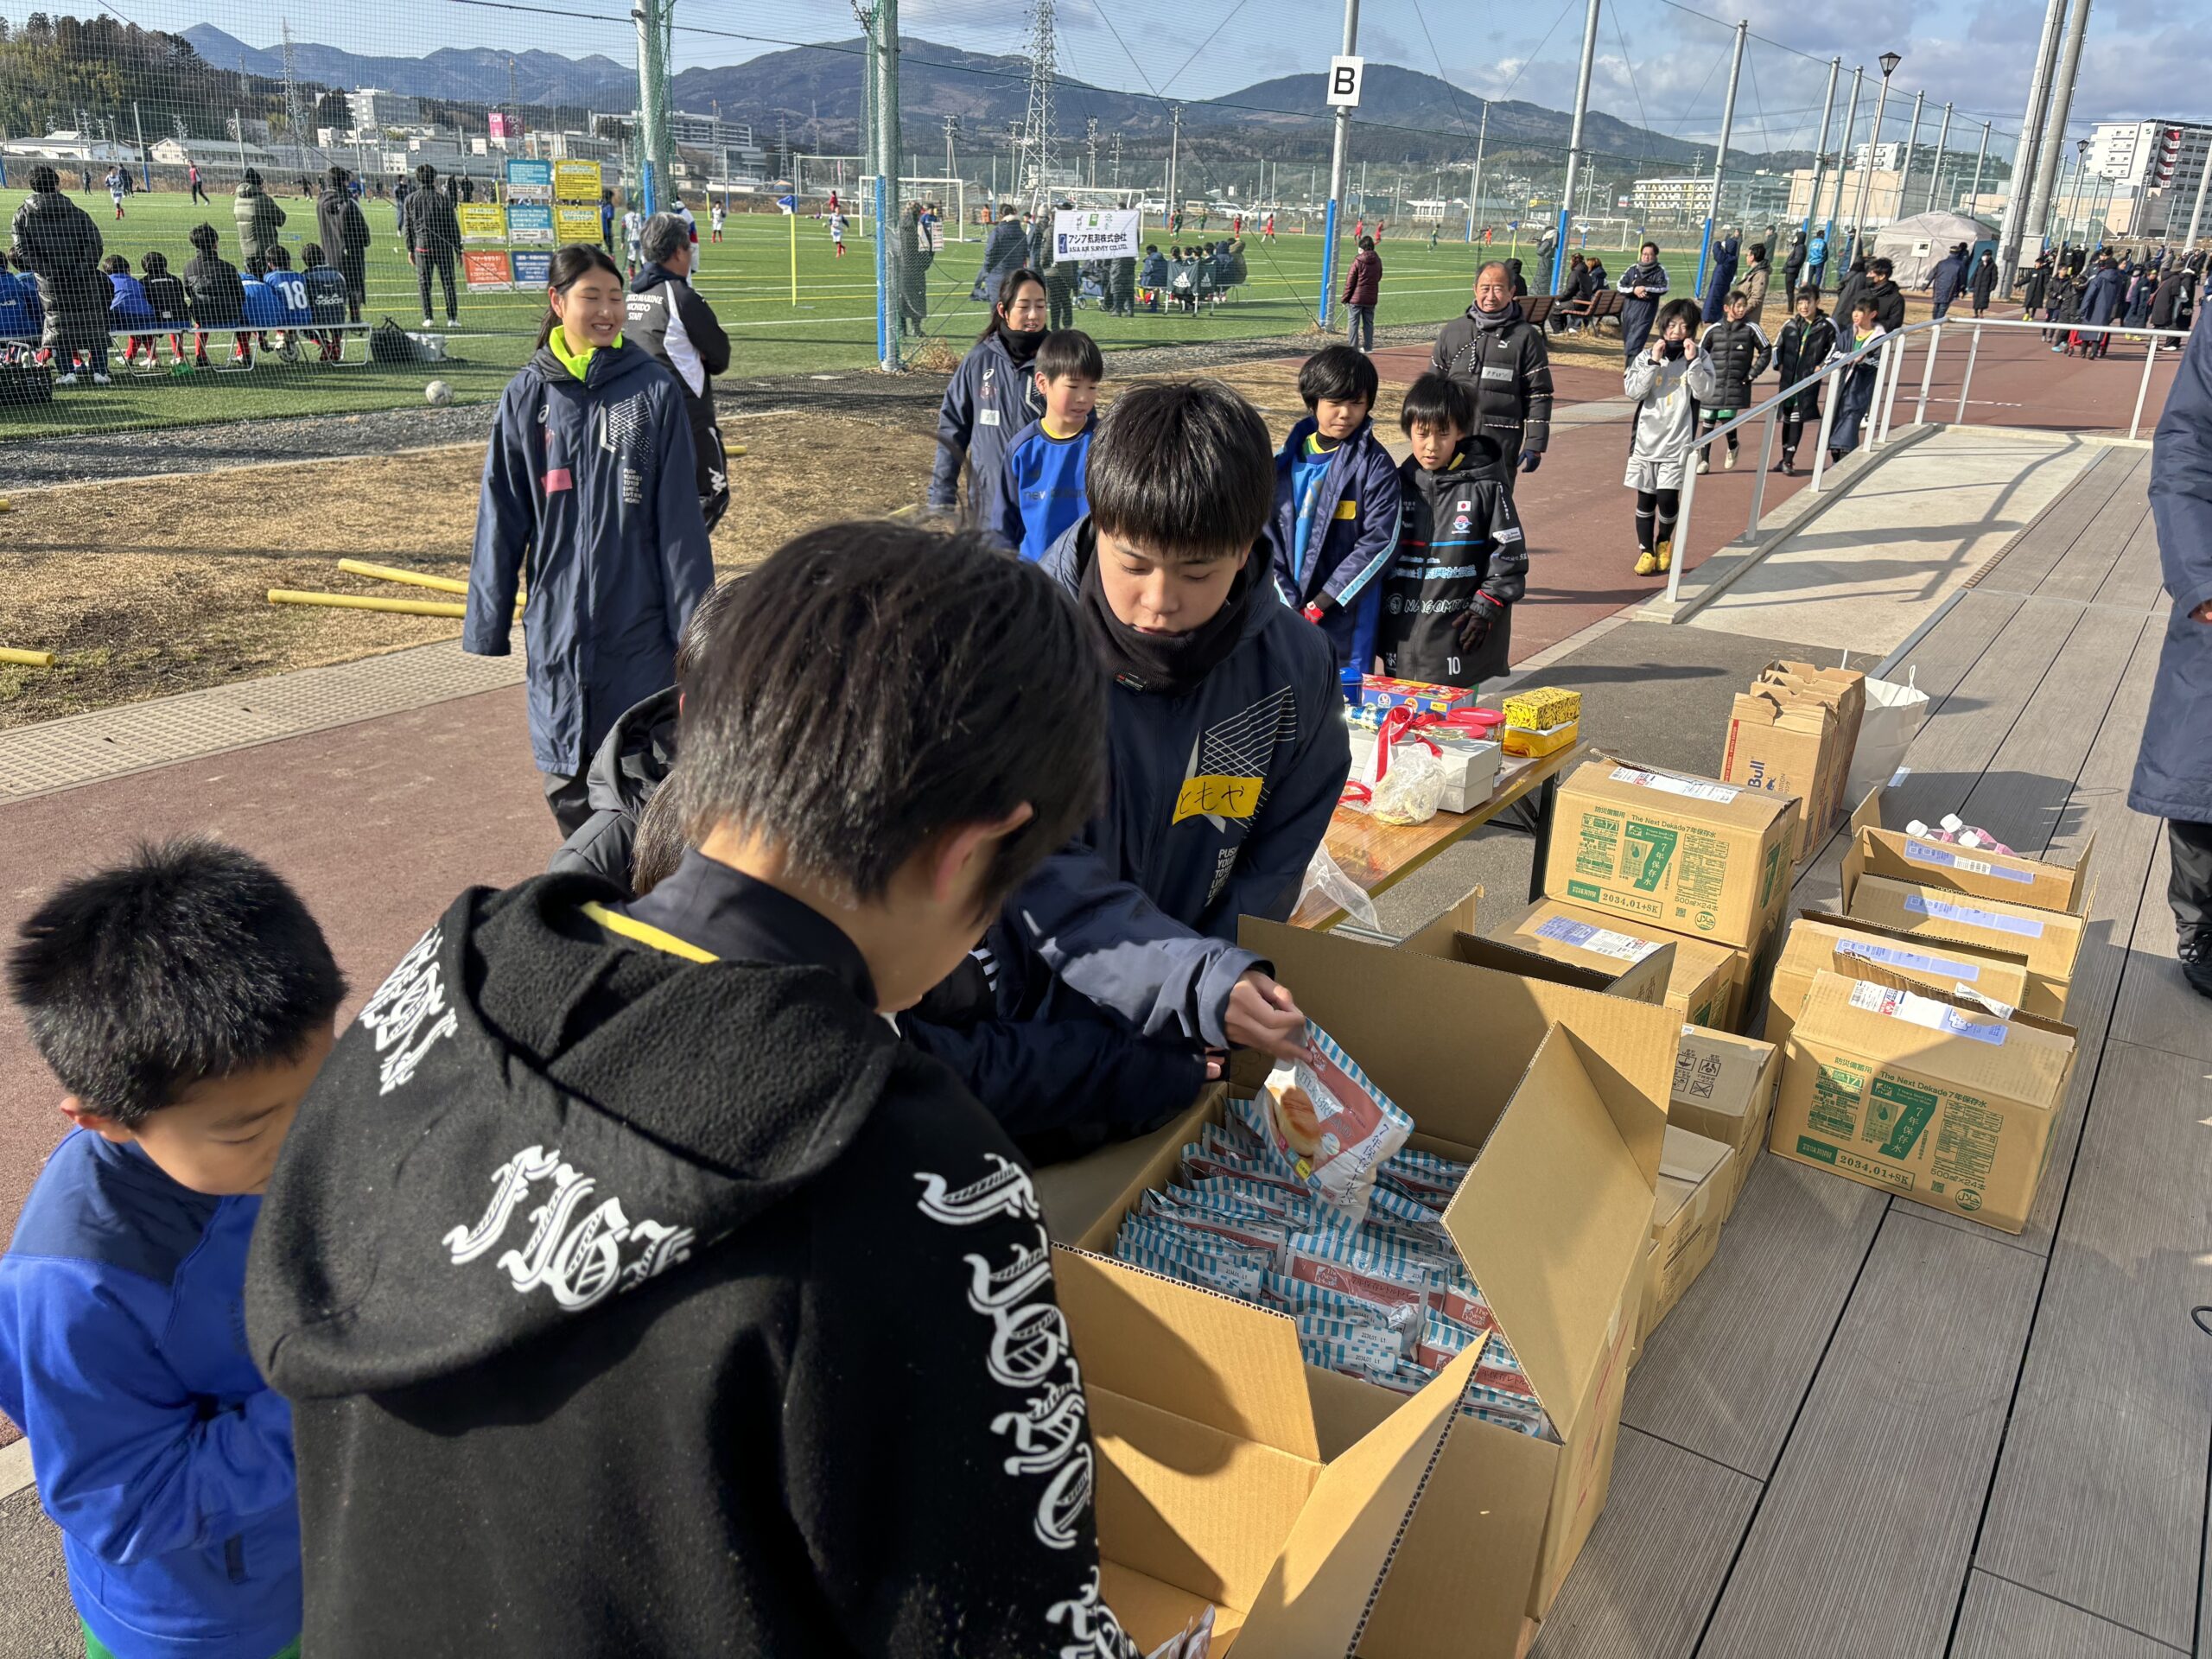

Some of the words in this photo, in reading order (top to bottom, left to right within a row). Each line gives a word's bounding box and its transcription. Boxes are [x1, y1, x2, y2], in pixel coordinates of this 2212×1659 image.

[1334, 67, 1355, 94] B
[279, 281, 308, 310] 18
[315, 296, 344, 305] adidas
[628, 312, 643, 321] STAFF
[1446, 657, 1461, 676] 10
[1747, 760, 1765, 788] Bull
[1179, 781, 1245, 815] ともや
[1605, 821, 1618, 831] 171
[1645, 817, 1660, 826] Next
[1662, 821, 1686, 831] Dekade
[1643, 842, 1667, 886] 7年保存水
[1602, 893, 1658, 913] 2034.01+SK
[1846, 1075, 1864, 1088] 171
[1880, 1071, 1895, 1080] The
[1897, 1076, 1916, 1086] Next
[1917, 1082, 1948, 1096] Dekade
[1891, 1107, 1923, 1154] 7年保存水
[1840, 1156, 1909, 1185] 2034.01+SK
[1476, 1306, 1488, 1316] The
